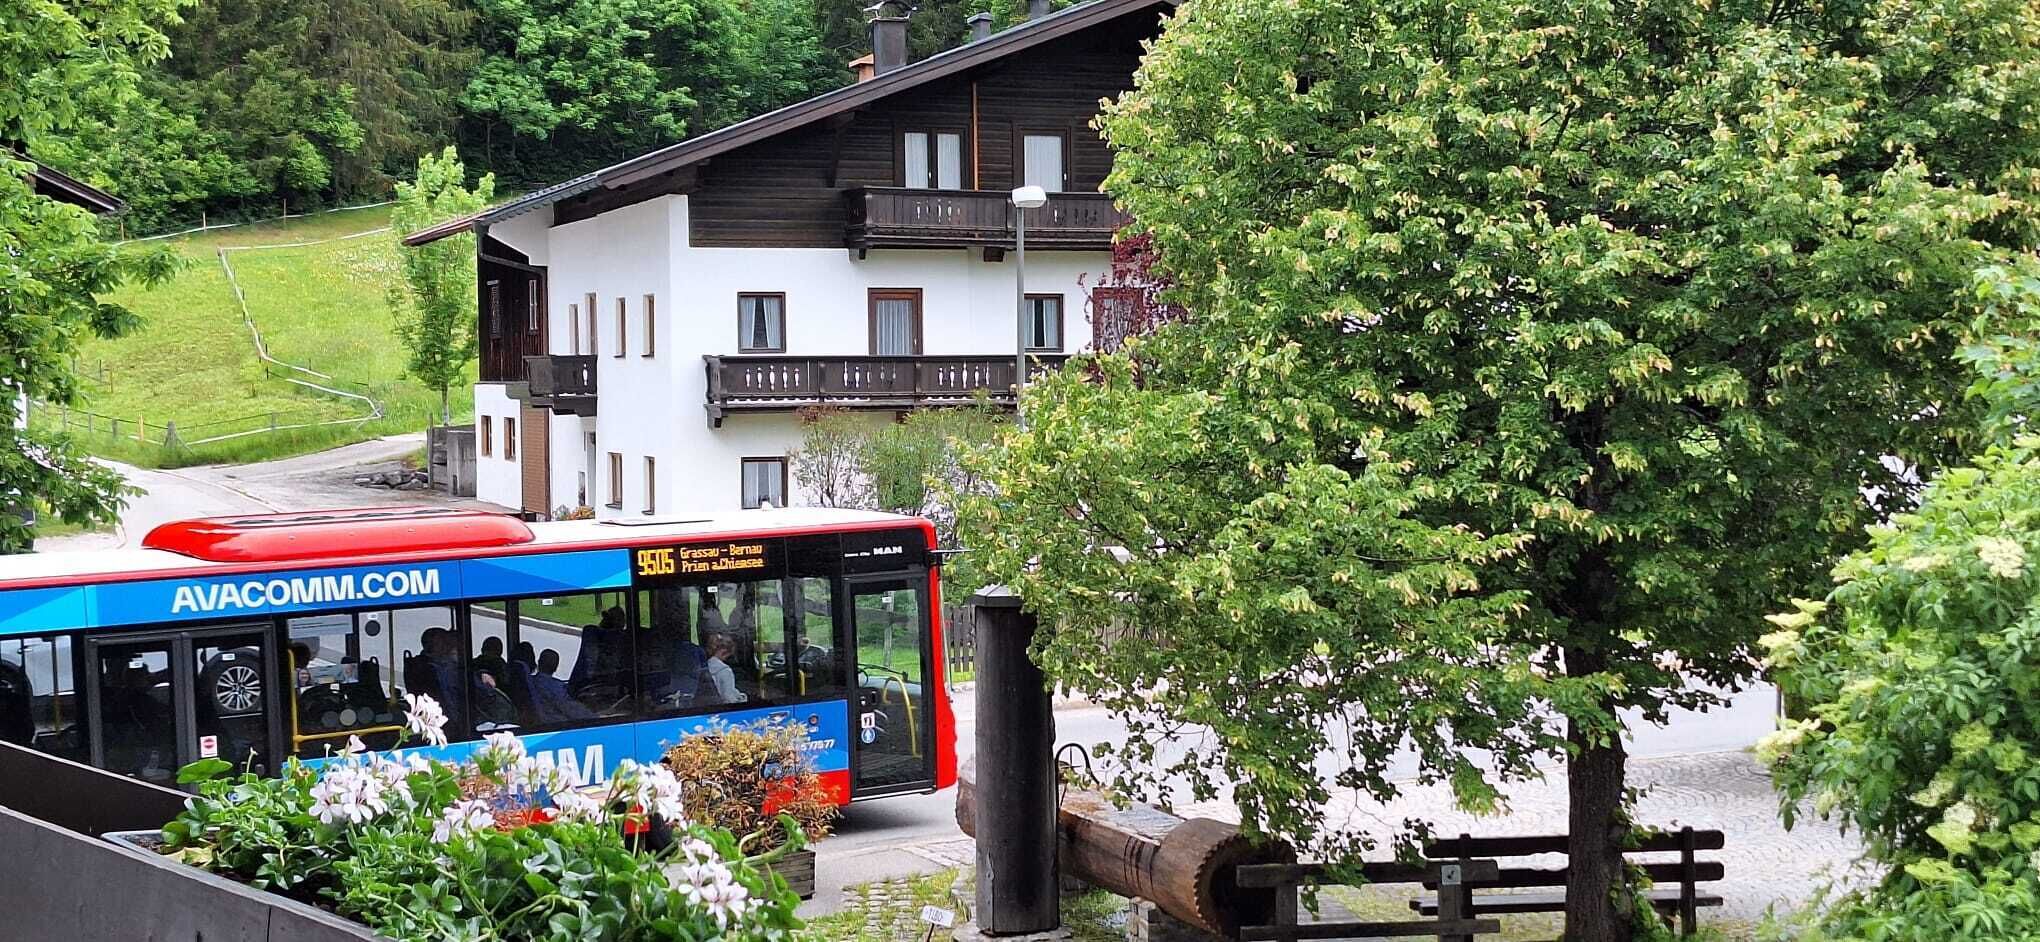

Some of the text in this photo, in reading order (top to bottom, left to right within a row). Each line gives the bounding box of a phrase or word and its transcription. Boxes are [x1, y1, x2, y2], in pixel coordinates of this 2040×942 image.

[680, 547, 720, 559] Grassau
[729, 544, 763, 556] Bernau
[873, 546, 903, 555] MAN
[637, 548, 675, 576] 9505
[681, 560, 710, 573] Prien
[171, 568, 441, 614] AVACOMM.COM
